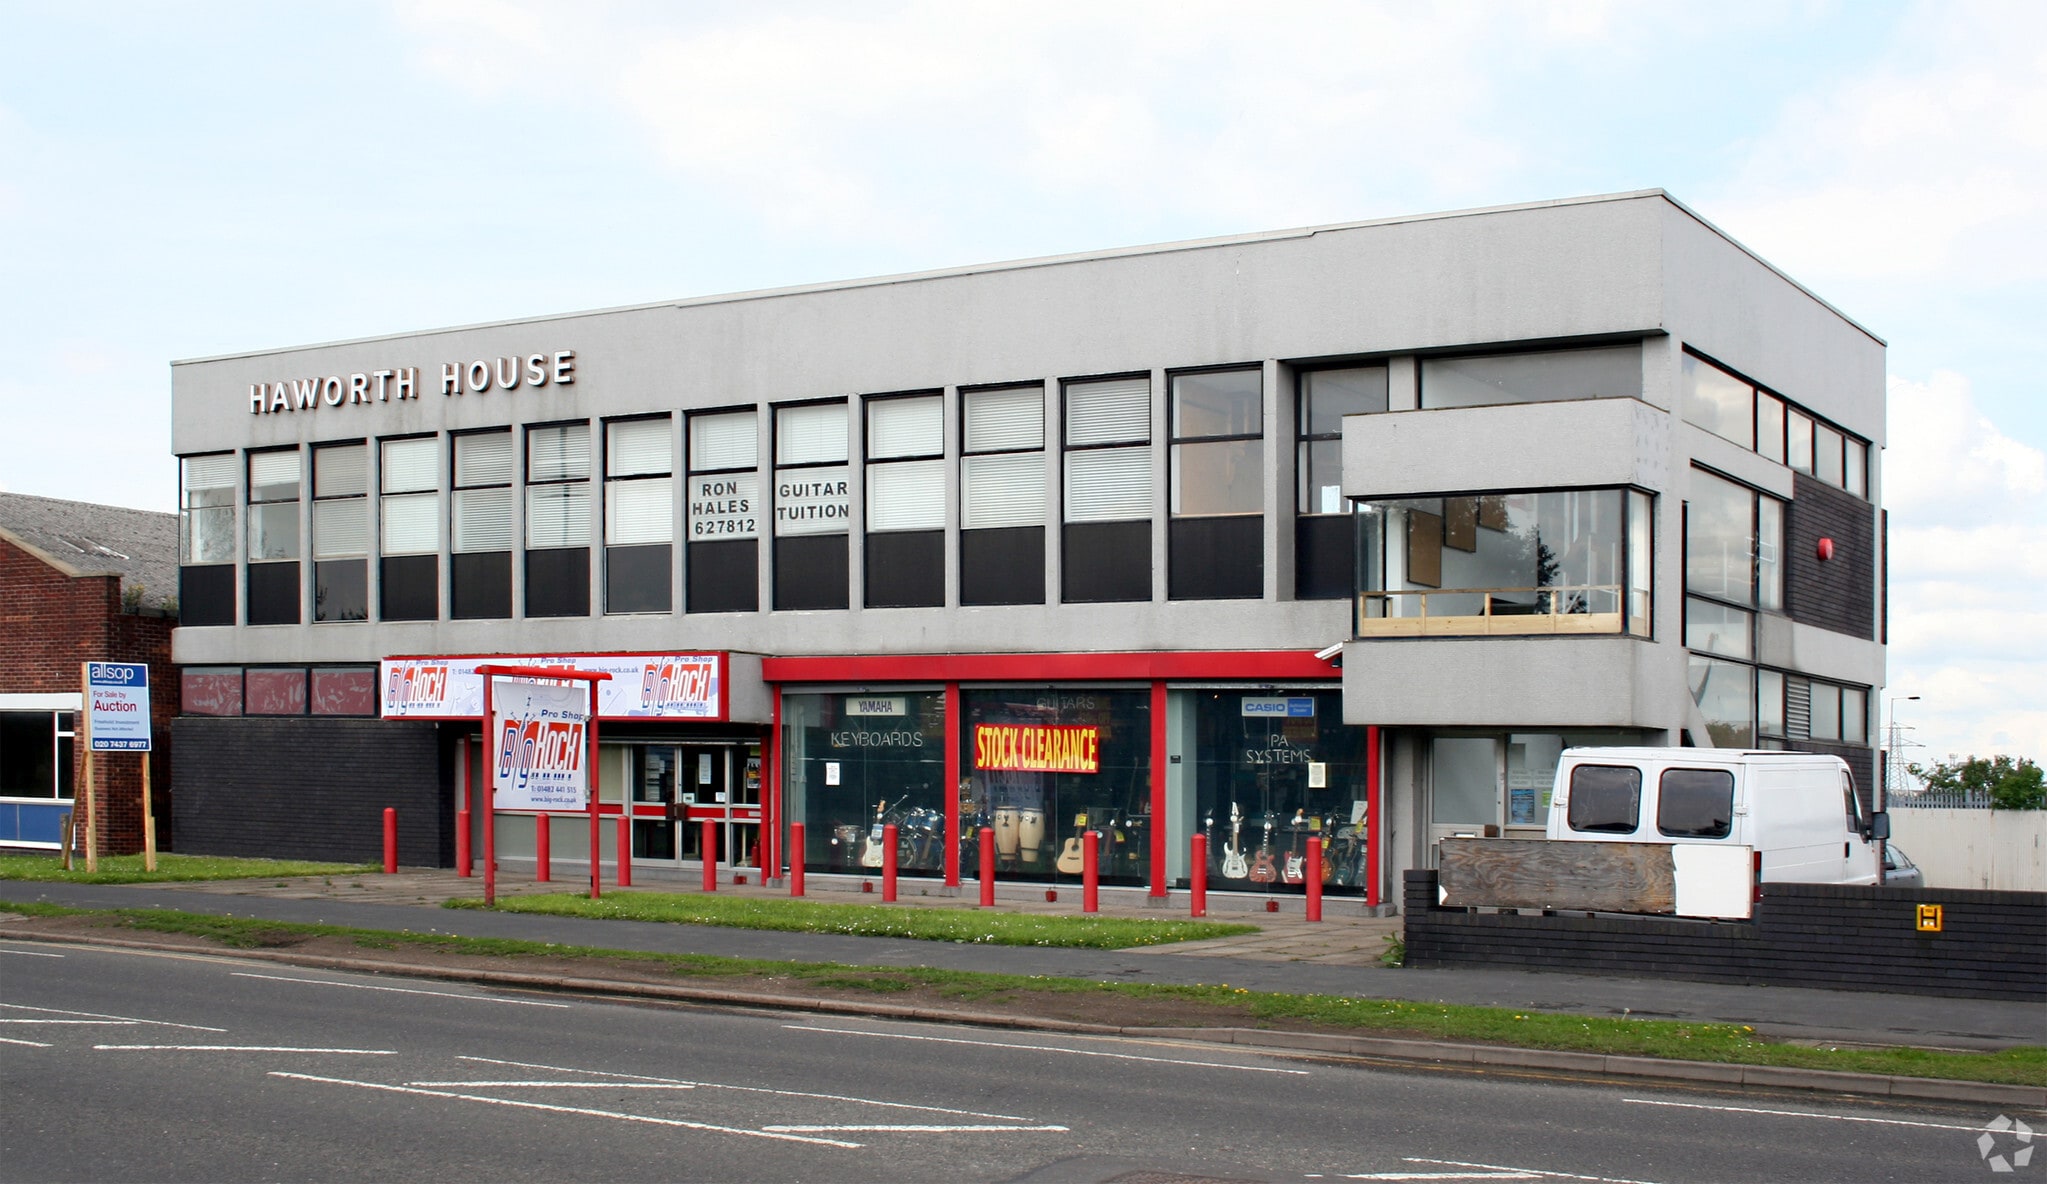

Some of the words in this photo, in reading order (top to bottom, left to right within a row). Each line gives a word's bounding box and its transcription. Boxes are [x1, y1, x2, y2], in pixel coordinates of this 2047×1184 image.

[250, 367, 419, 414] HAWORTH
[441, 350, 575, 396] HOUSE
[702, 481, 737, 497] RON
[779, 481, 848, 498] GUITAR
[692, 499, 750, 516] HALES
[777, 504, 849, 521] TUITION
[695, 519, 755, 535] 627812
[91, 664, 134, 685] allsop
[93, 690, 103, 698] For
[93, 700, 137, 712] Auction
[858, 701, 893, 713] YAMAHA
[1036, 696, 1096, 710] GUITARS
[1245, 703, 1286, 712] CASIO
[541, 709, 559, 718] Pro
[561, 710, 584, 720] Shop
[94, 740, 109, 748] 020
[110, 740, 128, 748] 7437
[830, 731, 924, 747] KEYBOARDS
[1270, 734, 1289, 747] PA
[977, 726, 1018, 768] STOCK
[1022, 727, 1096, 770] CLEARANCE
[1246, 749, 1312, 764] SYSTEMS
[536, 785, 555, 793] 01482
[555, 785, 566, 793] 441
[567, 786, 577, 794] 515
[1920, 907, 1937, 928] H
